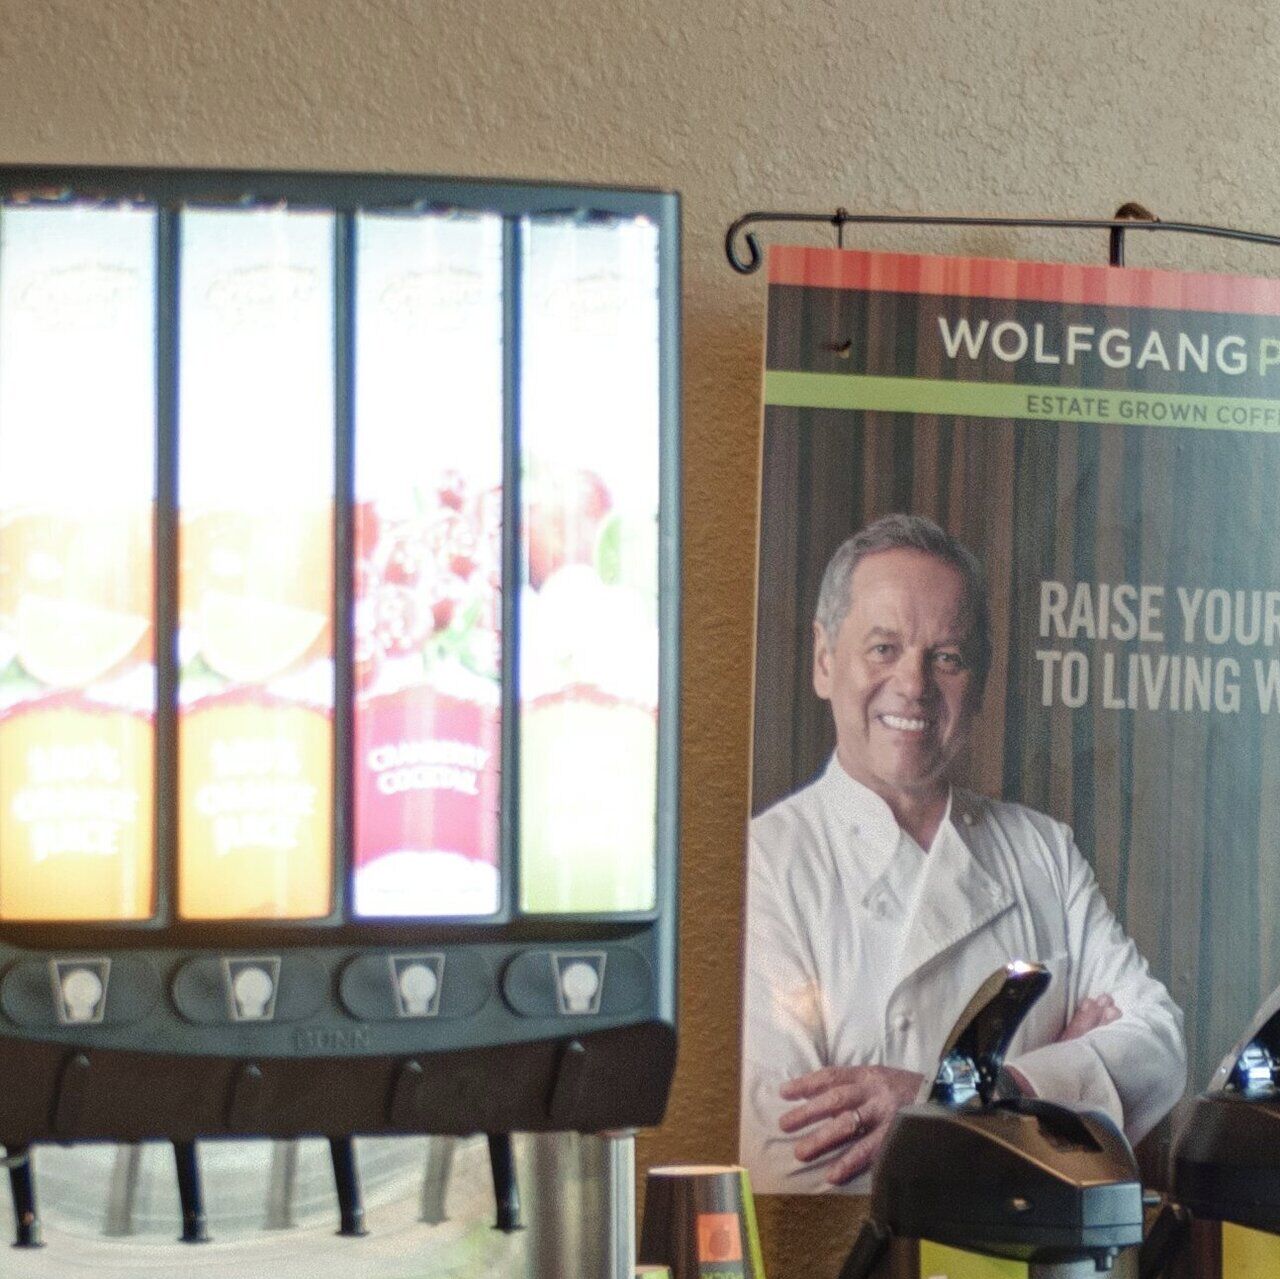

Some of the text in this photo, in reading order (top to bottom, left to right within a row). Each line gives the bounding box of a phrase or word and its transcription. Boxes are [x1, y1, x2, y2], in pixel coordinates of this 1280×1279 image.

[1027, 395, 1110, 418] ESTATE
[1118, 401, 1208, 424] GROWN
[1039, 581, 1165, 643] RAISE
[1035, 650, 1090, 708] TO
[1103, 652, 1241, 714] LIVING
